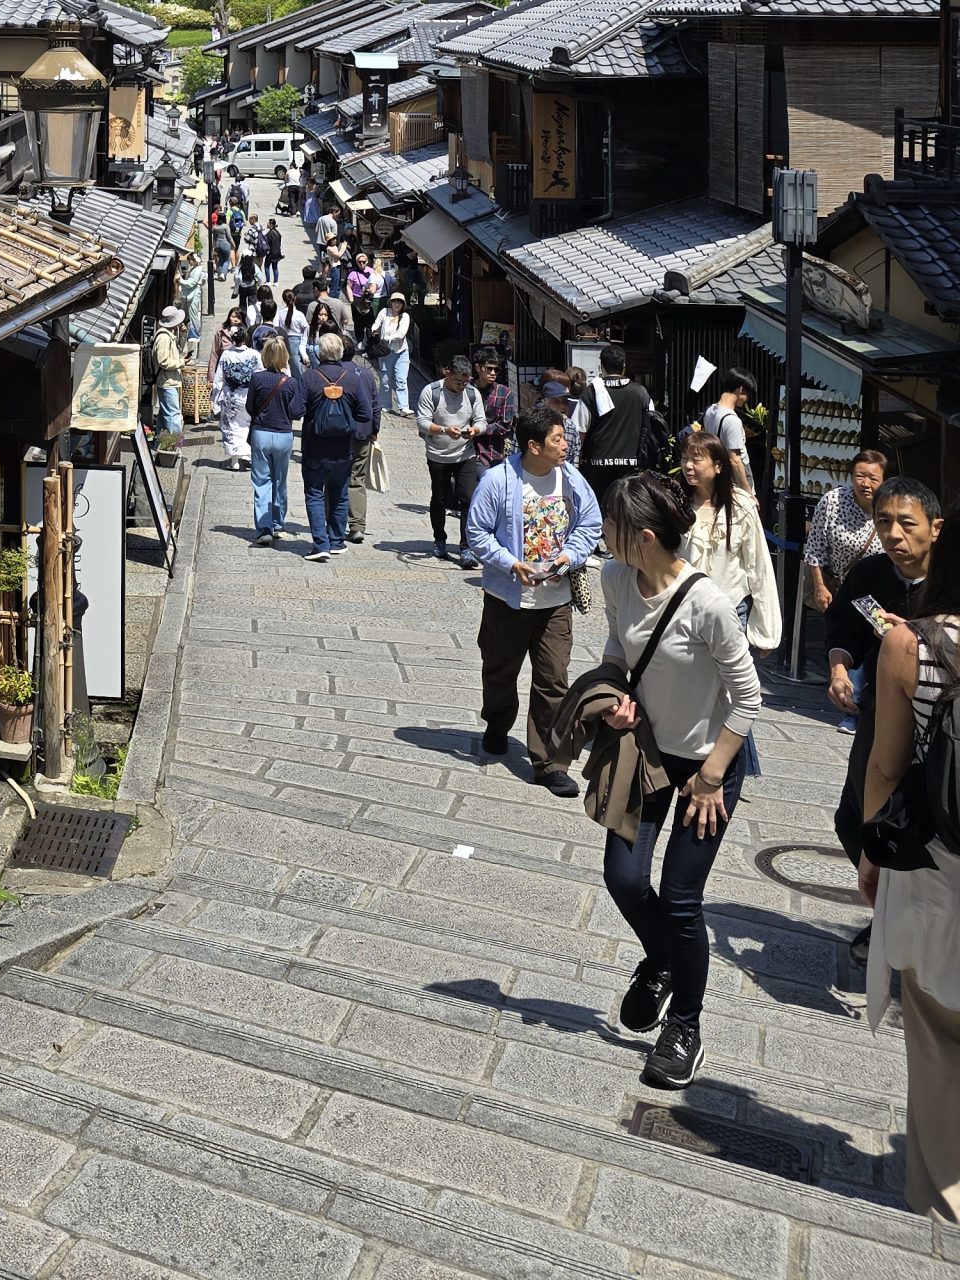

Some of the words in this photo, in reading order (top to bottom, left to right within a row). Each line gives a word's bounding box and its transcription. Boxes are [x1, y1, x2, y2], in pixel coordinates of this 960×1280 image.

[89, 356, 126, 397] 氷
[605, 379, 620, 387] ONE
[604, 458, 614, 466] AS
[614, 458, 628, 466] ONE
